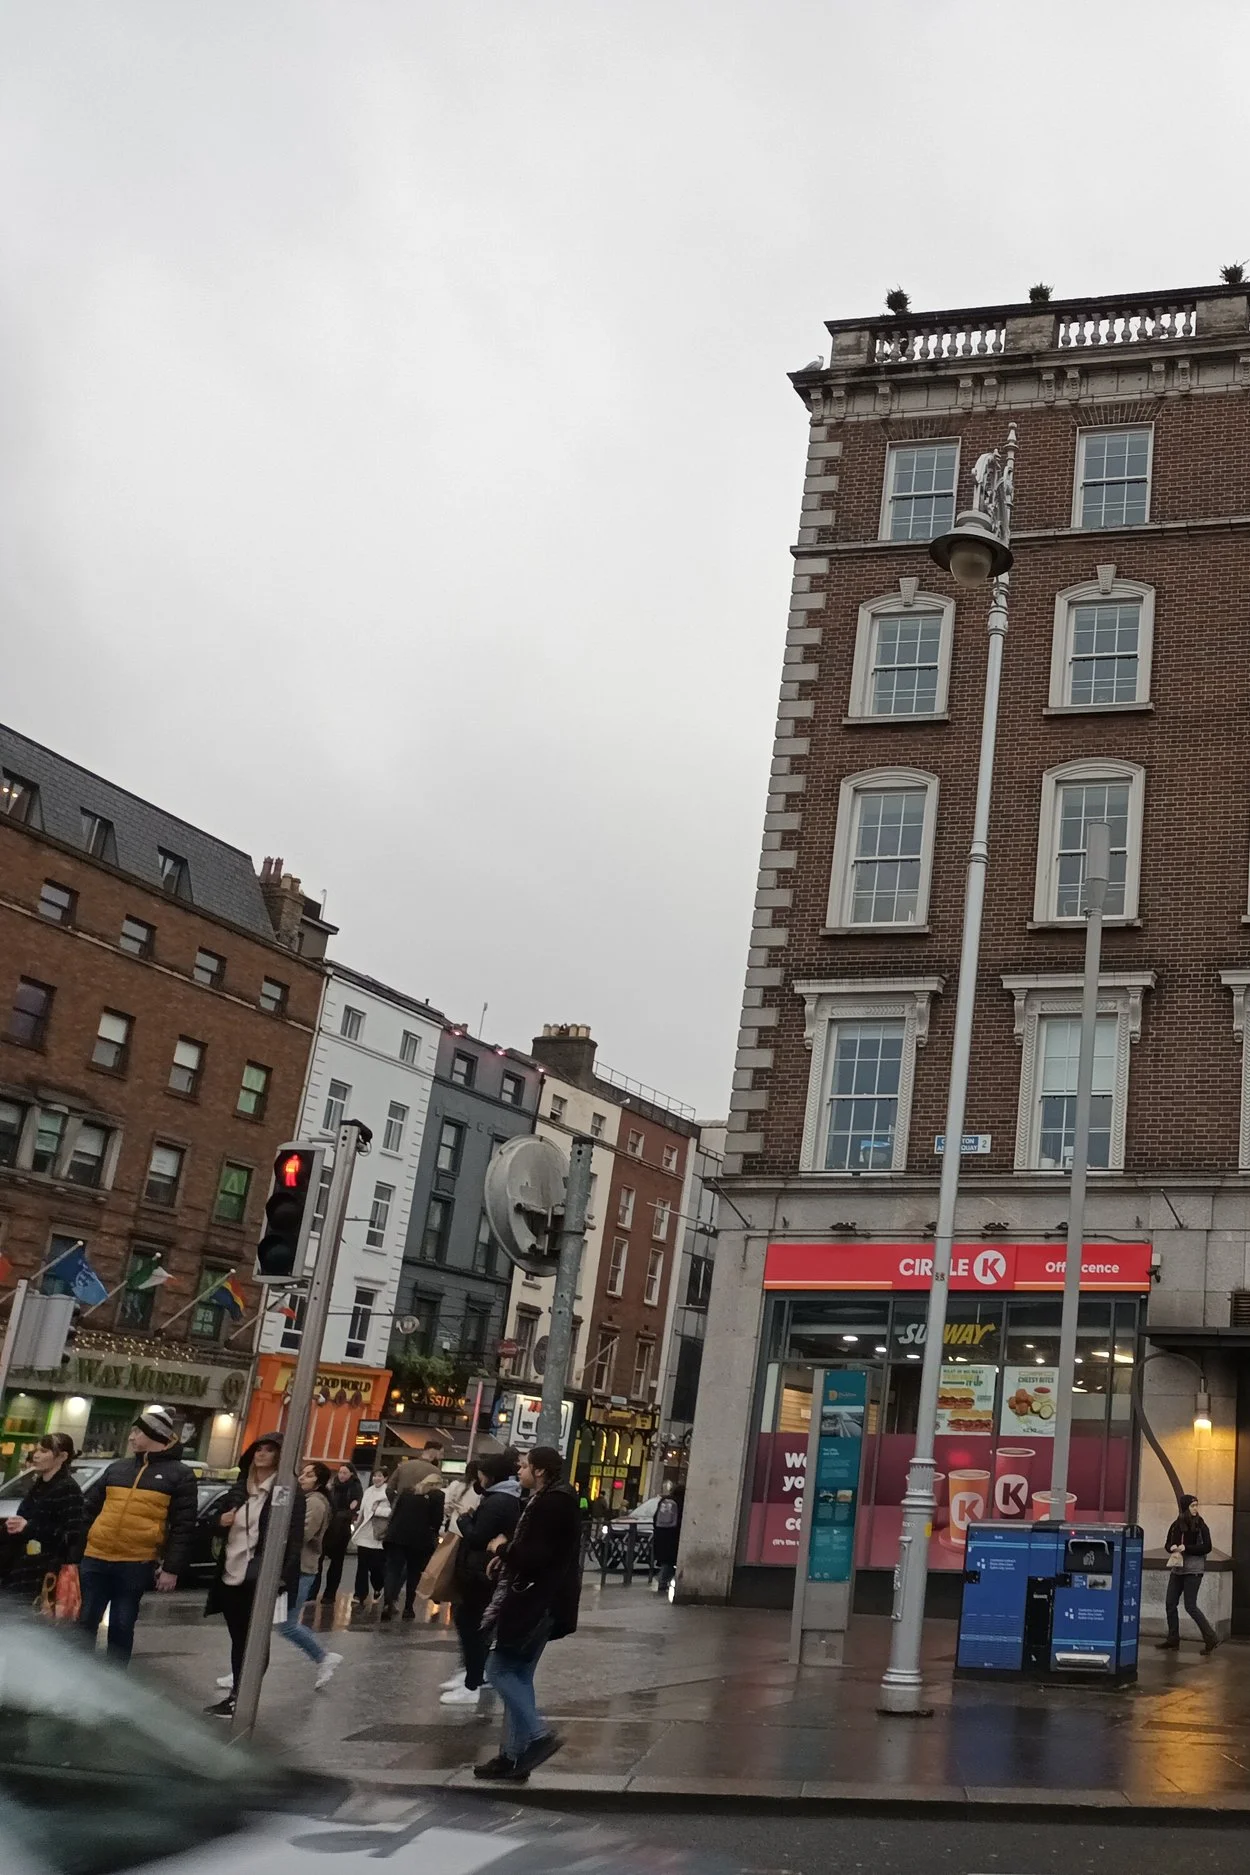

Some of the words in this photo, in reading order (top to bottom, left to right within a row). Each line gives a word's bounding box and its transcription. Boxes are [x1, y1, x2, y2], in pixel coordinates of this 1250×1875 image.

[981, 1139, 988, 1149] 2
[899, 1258, 970, 1277] CIRLE
[898, 1322, 996, 1345] SUWAY
[340, 1379, 372, 1393] WORLD
[999, 1478, 1027, 1511] K
[955, 1496, 982, 1526] K
